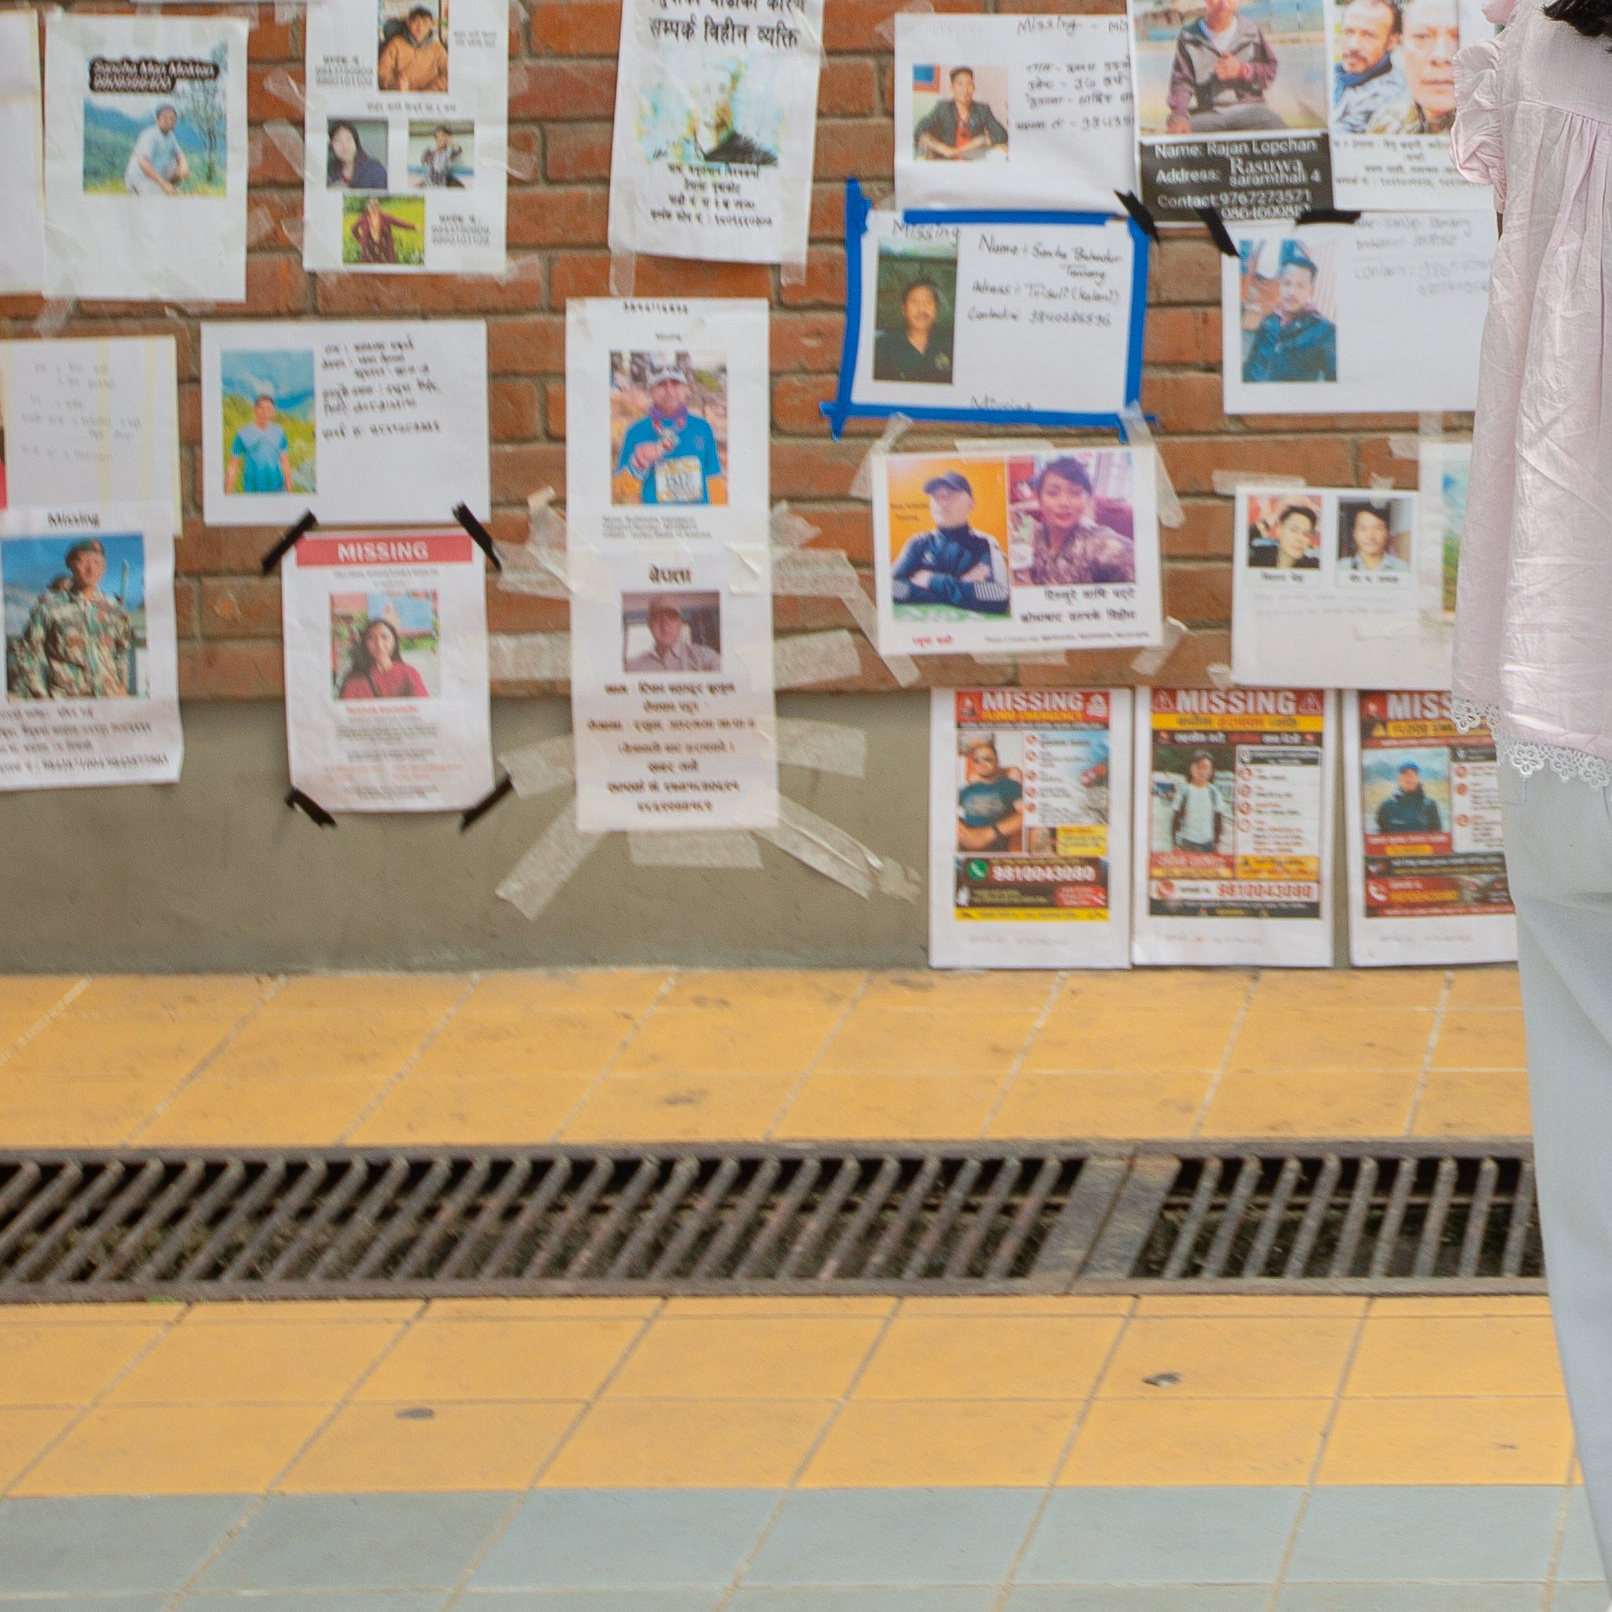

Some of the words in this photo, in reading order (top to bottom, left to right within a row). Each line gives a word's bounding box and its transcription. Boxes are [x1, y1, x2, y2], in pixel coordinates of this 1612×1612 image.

[649, 12, 698, 41] सम्पर्क
[703, 13, 748, 42] विहीन
[756, 19, 800, 48] व्यक्ति
[1155, 143, 1203, 159] Name:
[1207, 141, 1251, 160] Rajan
[1252, 138, 1317, 157] Lopchan
[1155, 167, 1221, 186] Address:
[1229, 155, 1304, 175] Rasuwa
[337, 540, 429, 562] MISSING
[982, 689, 1084, 712] MISSING
[1176, 690, 1298, 715] MISSING
[1386, 692, 1452, 720] MISS
